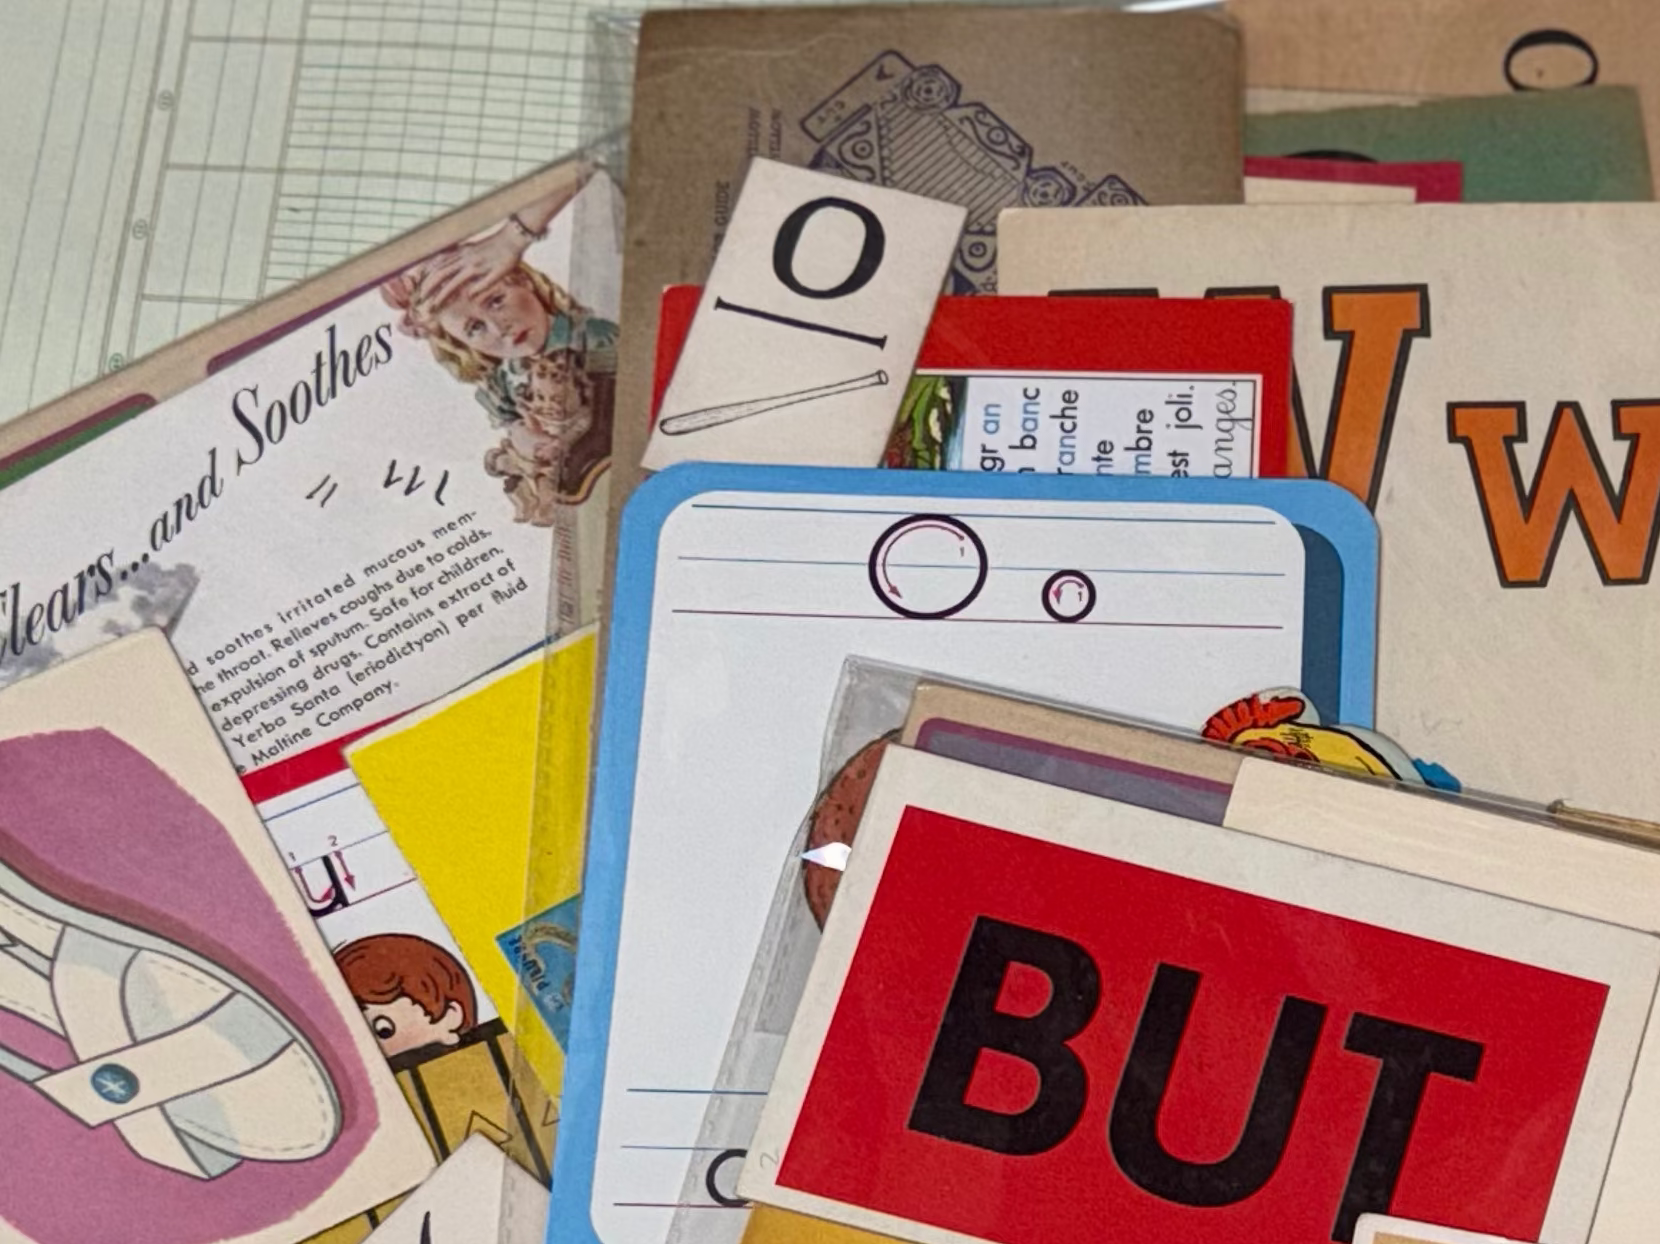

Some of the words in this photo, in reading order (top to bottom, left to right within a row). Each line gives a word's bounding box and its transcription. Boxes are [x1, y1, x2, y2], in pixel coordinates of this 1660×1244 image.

[231, 322, 393, 476] Soothes
[1008, 387, 1041, 449] banc
[1049, 389, 1079, 475] ranche
[1091, 439, 1114, 475] nte
[1124, 408, 1154, 475] mbre
[1165, 385, 1203, 429] joli.
[207, 622, 273, 666] soothes
[277, 574, 356, 625] irritated
[363, 539, 425, 577] mucous
[432, 510, 477, 539] mem-
[210, 665, 285, 712] expulsion
[289, 652, 306, 670] of
[310, 622, 368, 662] sputum.
[369, 596, 409, 622] Safe
[410, 581, 434, 601] for
[436, 546, 503, 587] children.
[217, 650, 271, 684] throat.
[271, 611, 337, 651] Relieves
[340, 580, 394, 615] coughs
[396, 564, 425, 584] due
[426, 550, 444, 566] to
[447, 527, 492, 555] colds.
[222, 680, 309, 732] depressing
[312, 652, 363, 682] drugs.
[364, 604, 434, 649] Contains
[438, 573, 494, 610] extract
[497, 557, 516, 577] of
[231, 715, 287, 748] Yerba
[290, 683, 341, 716] Santa
[346, 622, 449, 687] (eriodictyon)
[455, 602, 484, 628] per
[253, 726, 312, 766] Maltine
[316, 678, 399, 728] Company.
